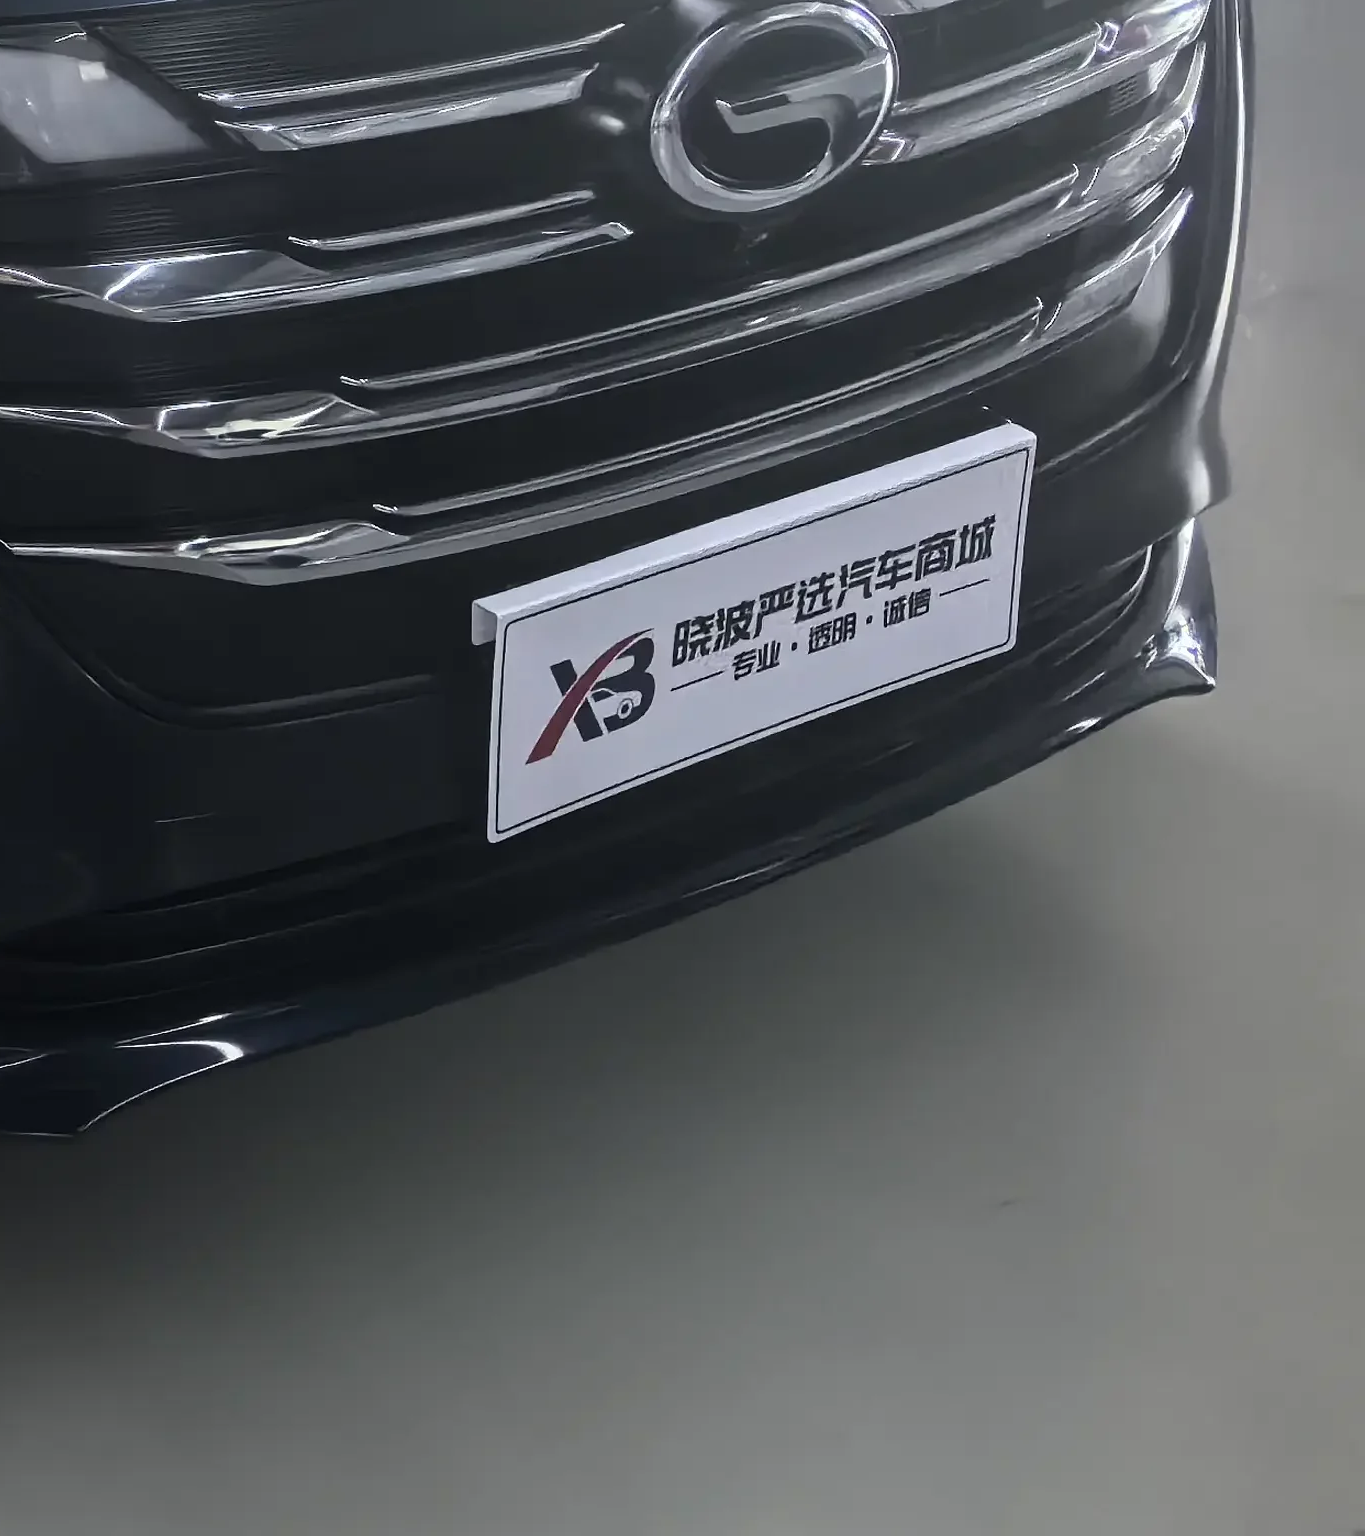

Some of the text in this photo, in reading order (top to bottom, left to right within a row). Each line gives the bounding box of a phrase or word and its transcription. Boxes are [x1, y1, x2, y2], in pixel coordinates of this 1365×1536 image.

[672, 514, 996, 665] 晓波严选汽车商城
